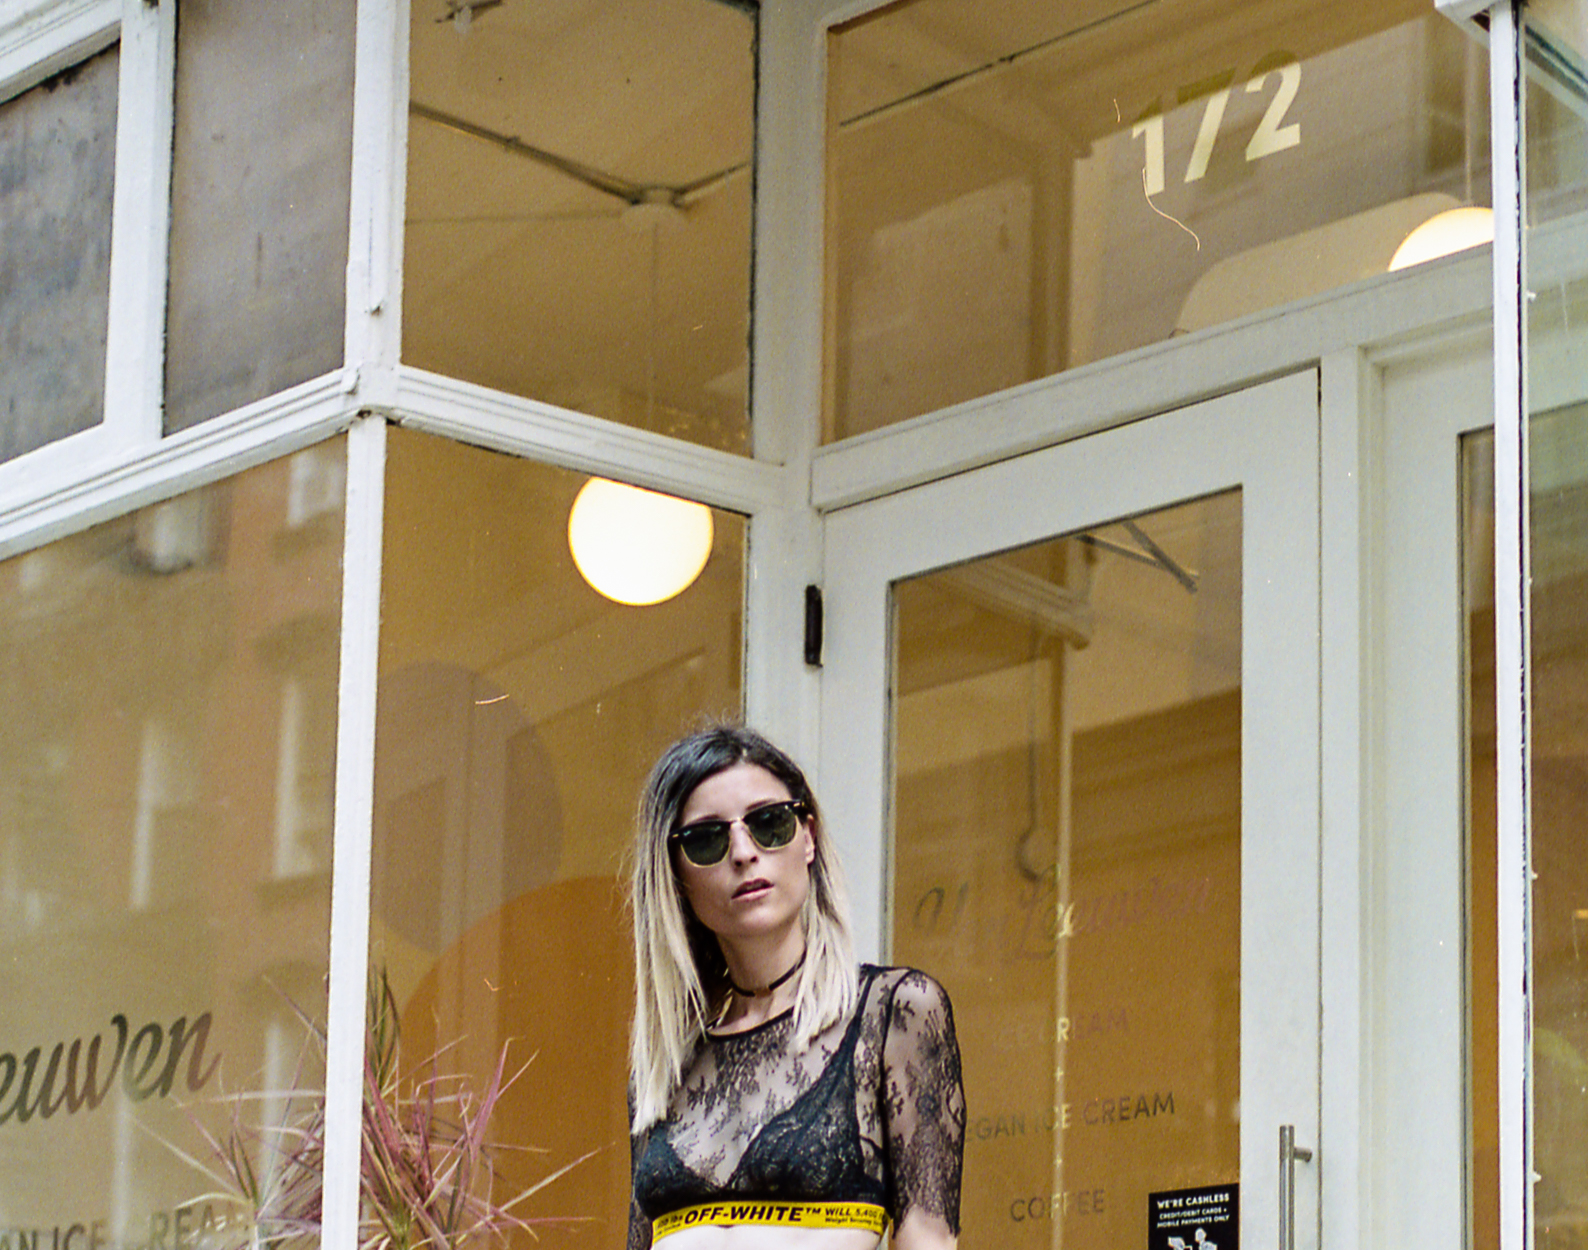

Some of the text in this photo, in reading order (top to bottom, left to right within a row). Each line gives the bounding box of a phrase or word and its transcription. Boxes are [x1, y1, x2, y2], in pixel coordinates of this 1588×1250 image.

[1132, 49, 1302, 198] 172
[1083, 1091, 1176, 1126] CREAM
[825, 1208, 852, 1217] WILL
[1010, 1189, 1106, 1223] COFFEE
[1157, 1193, 1230, 1210] WE'RE CASHLESS
[1157, 1219, 1179, 1228] MOBILE
[1181, 1216, 1212, 1226] PAYMENTS
